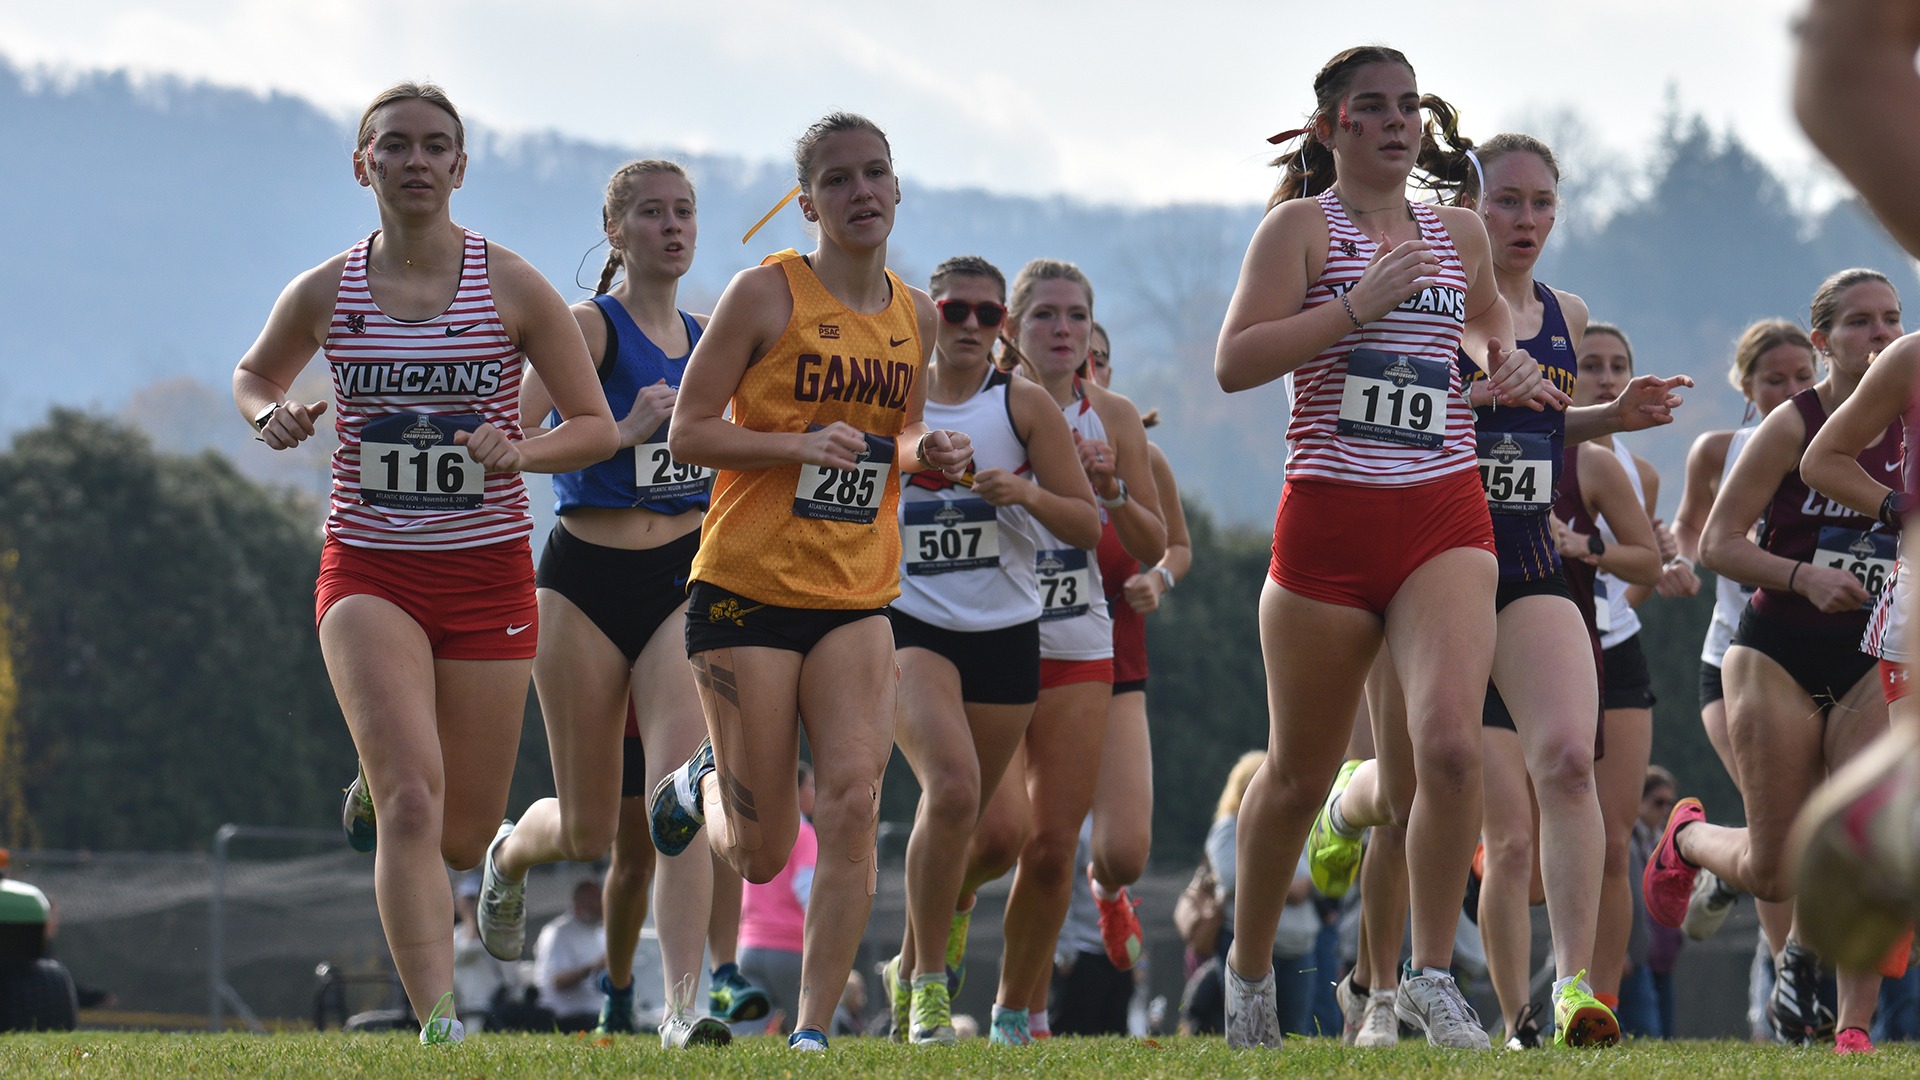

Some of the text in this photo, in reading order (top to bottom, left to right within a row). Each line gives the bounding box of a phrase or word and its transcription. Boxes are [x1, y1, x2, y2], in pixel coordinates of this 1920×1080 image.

[818, 328, 840, 336] PSAC
[330, 360, 504, 399] VULCANS
[794, 353, 914, 413] GANNO
[1362, 385, 1433, 431] 119
[1352, 423, 1374, 432] ATLANTIC
[1374, 426, 1392, 435] REGION
[1395, 430, 1416, 438] November
[380, 450, 464, 493] 116
[812, 465, 878, 507] 285
[919, 528, 982, 561] 507
[1035, 576, 1078, 608] 73
[1829, 558, 1885, 596] 66
